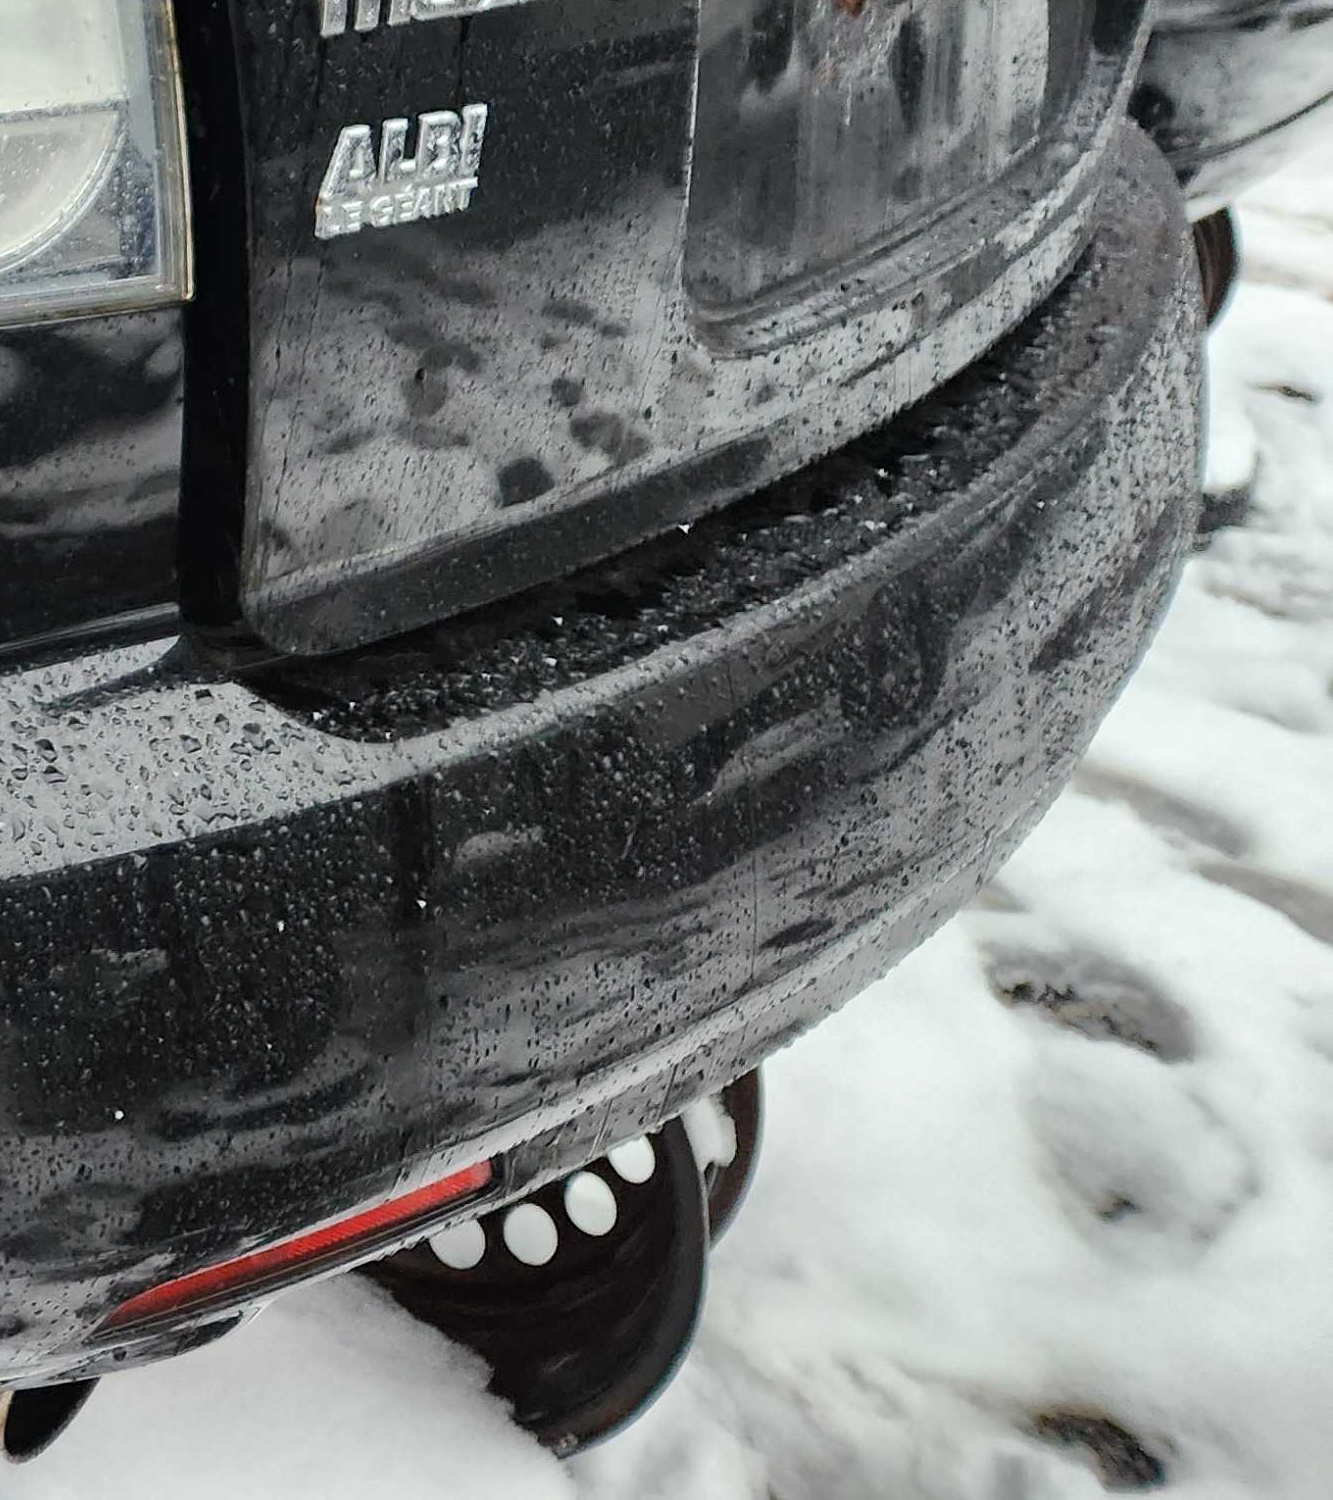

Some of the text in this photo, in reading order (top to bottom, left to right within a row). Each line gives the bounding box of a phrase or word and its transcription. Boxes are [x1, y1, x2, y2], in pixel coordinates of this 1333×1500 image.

[317, 103, 489, 201] ALBI
[315, 177, 479, 239] LE GÉANT
